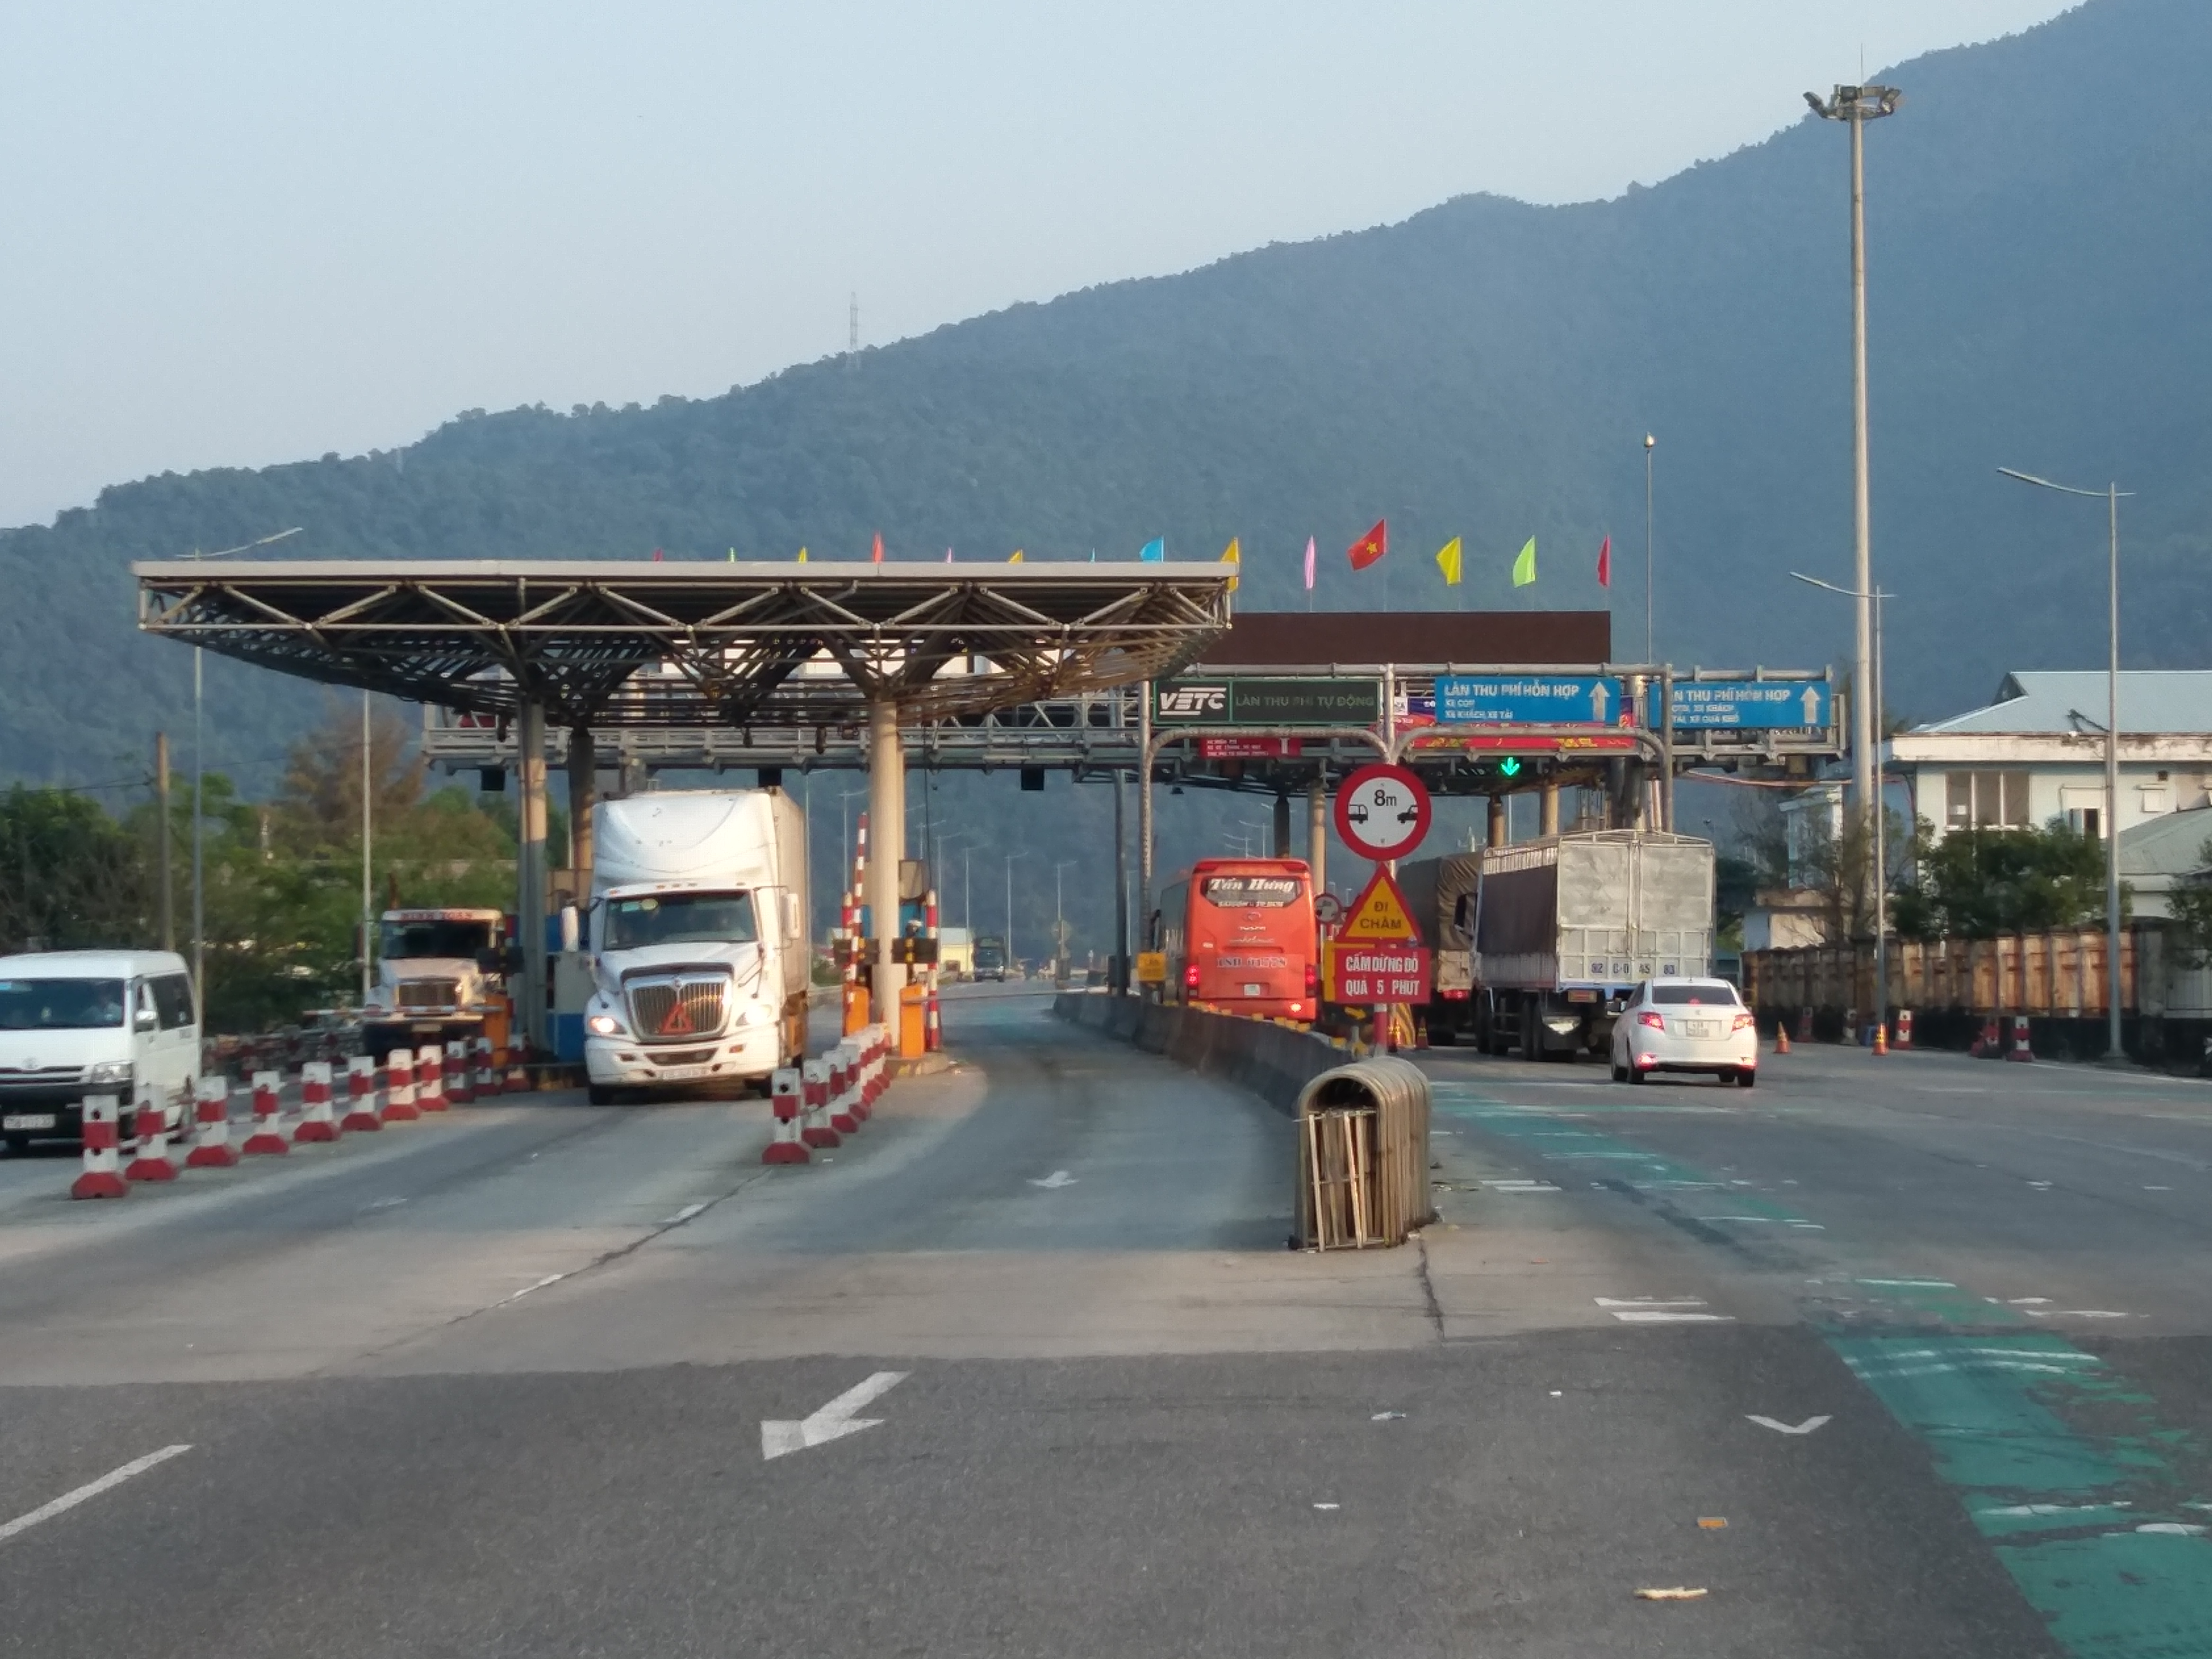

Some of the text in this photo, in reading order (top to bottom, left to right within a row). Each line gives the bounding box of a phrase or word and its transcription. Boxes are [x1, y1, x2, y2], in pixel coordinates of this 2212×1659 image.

[1445, 681, 1470, 696] LÀN
[1473, 685, 1498, 696] THU
[1501, 680, 1523, 696] PHÍ
[1553, 684, 1580, 700] HỢP
[1686, 689, 1710, 701] THU
[1160, 692, 1225, 710] VETC
[1264, 696, 1289, 706] THU
[1374, 789, 1397, 807] 8m
[1374, 901, 1389, 912] ĐI
[1346, 951, 1371, 972] CẤM
[1377, 979, 1384, 995] 5
[1392, 975, 1420, 996] PHÚT
